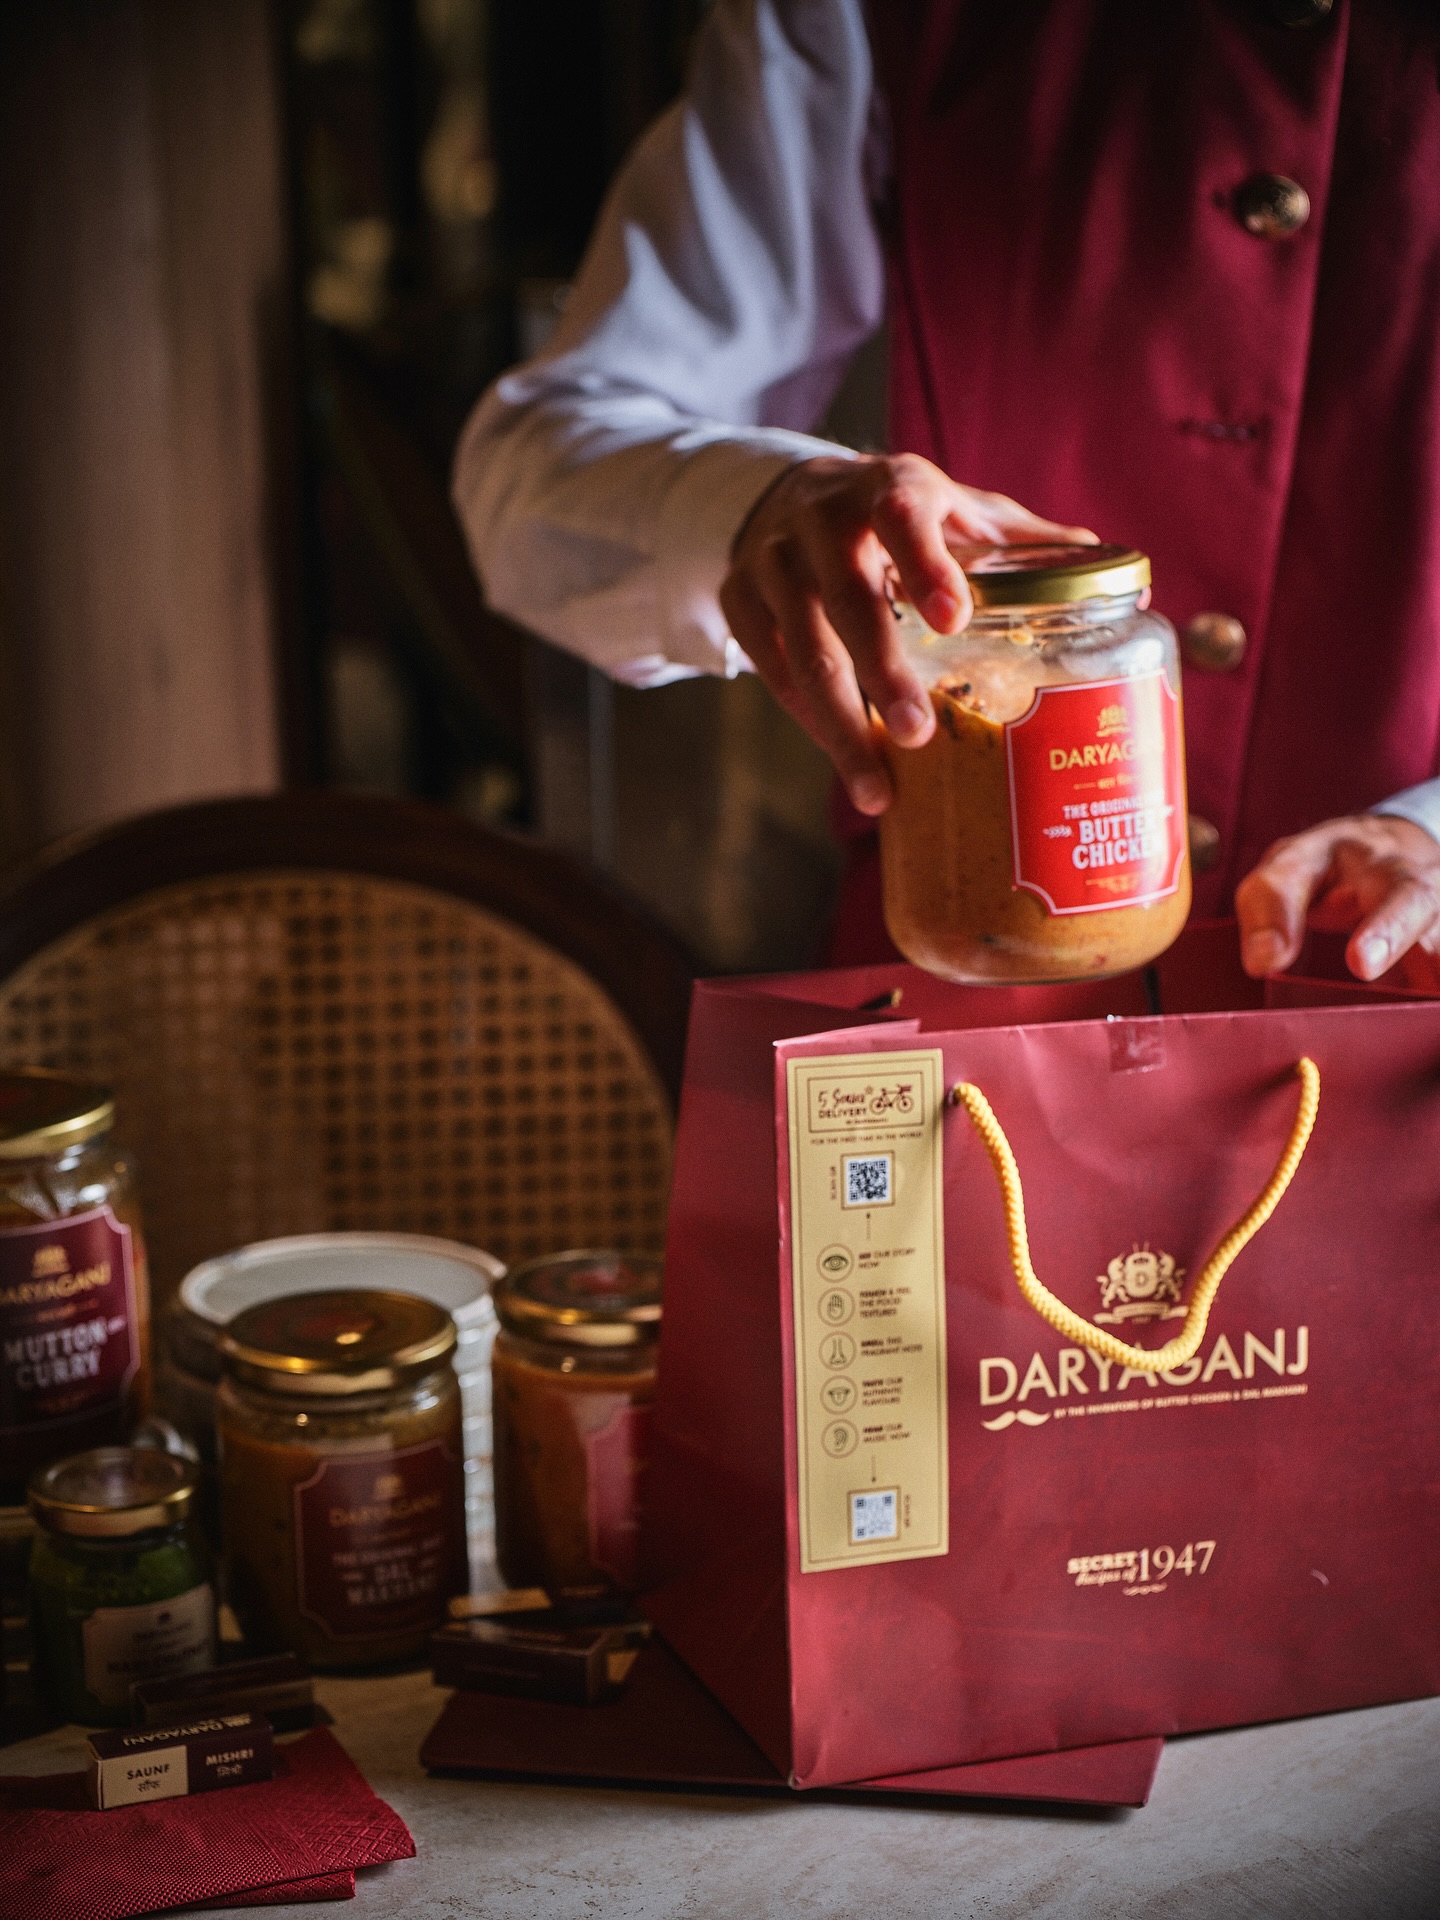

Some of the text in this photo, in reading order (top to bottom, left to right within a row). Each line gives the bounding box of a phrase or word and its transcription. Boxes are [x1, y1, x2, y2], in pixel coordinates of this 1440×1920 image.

[1062, 803, 1088, 820] THE
[818, 1107, 867, 1119] DELIVERY
[4, 1317, 108, 1362] MUTTON
[1053, 1408, 1066, 1419] BY
[1067, 1405, 1085, 1416] THE
[1086, 1401, 1140, 1415] INVENTORS
[1141, 1399, 1153, 1410] OF
[1154, 1395, 1189, 1408] BUTTER
[1066, 1550, 1139, 1574] SECRET
[1138, 1540, 1217, 1582] 1947
[205, 1748, 254, 1766] MISHRI
[126, 1763, 171, 1780] SAUNF
